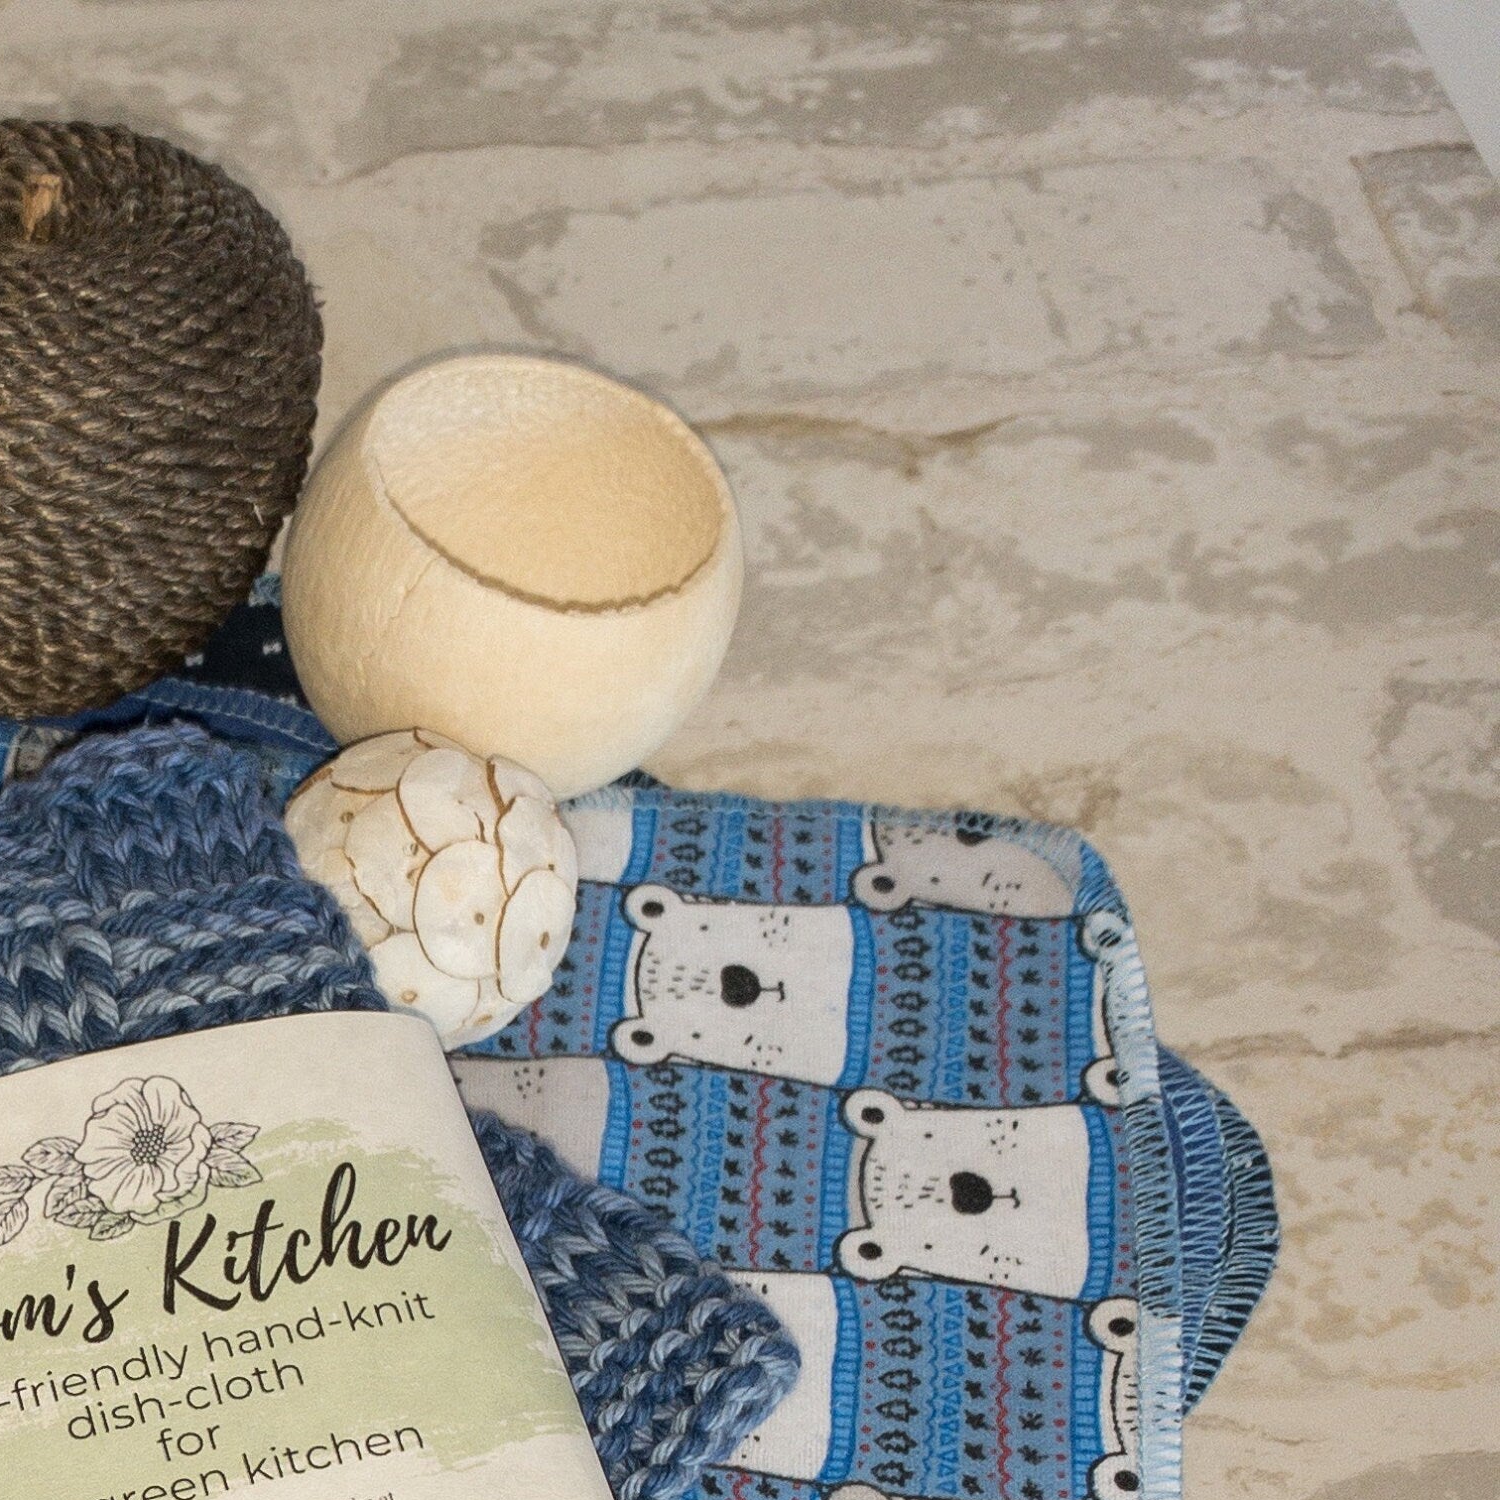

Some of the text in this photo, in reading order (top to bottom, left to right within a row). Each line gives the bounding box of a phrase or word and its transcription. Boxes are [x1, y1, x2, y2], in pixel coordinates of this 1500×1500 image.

[162, 1162, 452, 1314] Kitchen
[203, 1290, 436, 1361] hand-knit
[66, 1357, 304, 1442] dish-cloth
[157, 1421, 221, 1463] for
[243, 1423, 424, 1486] kitchen
